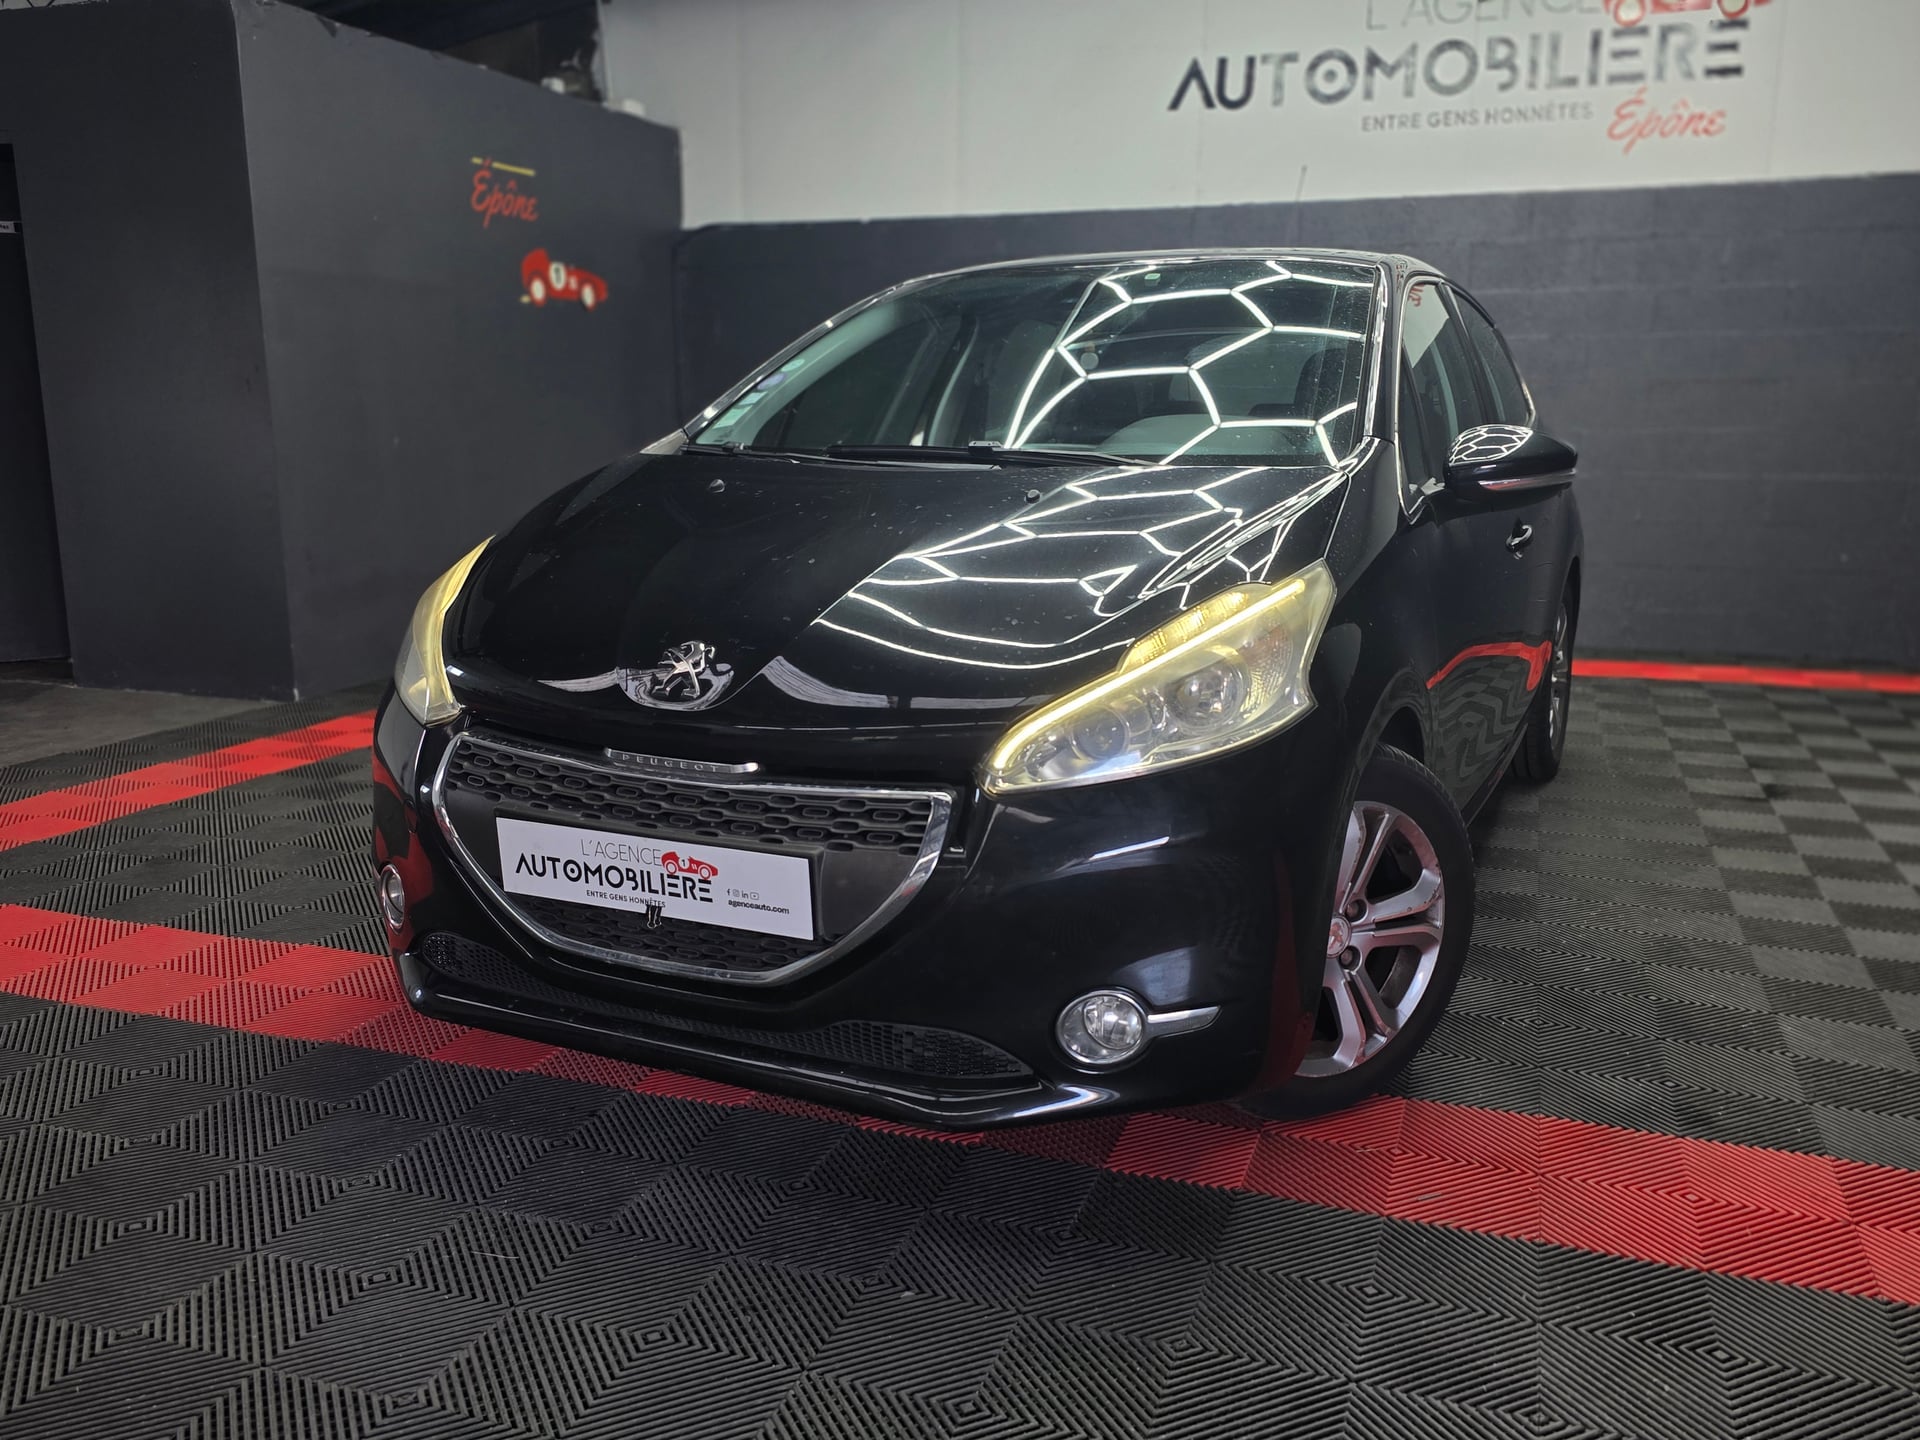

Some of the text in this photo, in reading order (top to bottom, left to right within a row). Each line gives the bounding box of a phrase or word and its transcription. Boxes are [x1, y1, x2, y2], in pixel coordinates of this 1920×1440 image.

[1168, 19, 1749, 111] AUTOMOBILIERE
[1361, 100, 1594, 132] ENTRE GENS HONNÊTES
[1607, 86, 1727, 155] Épône
[471, 156, 538, 229] Épône
[622, 753, 719, 773] PEUGEOT
[580, 839, 662, 867] L'AGENCE
[515, 853, 714, 903] AUTOMOBILIERE
[586, 889, 608, 899] ENTRE
[609, 893, 628, 902] GENS
[728, 899, 790, 915] agenceauto.com
